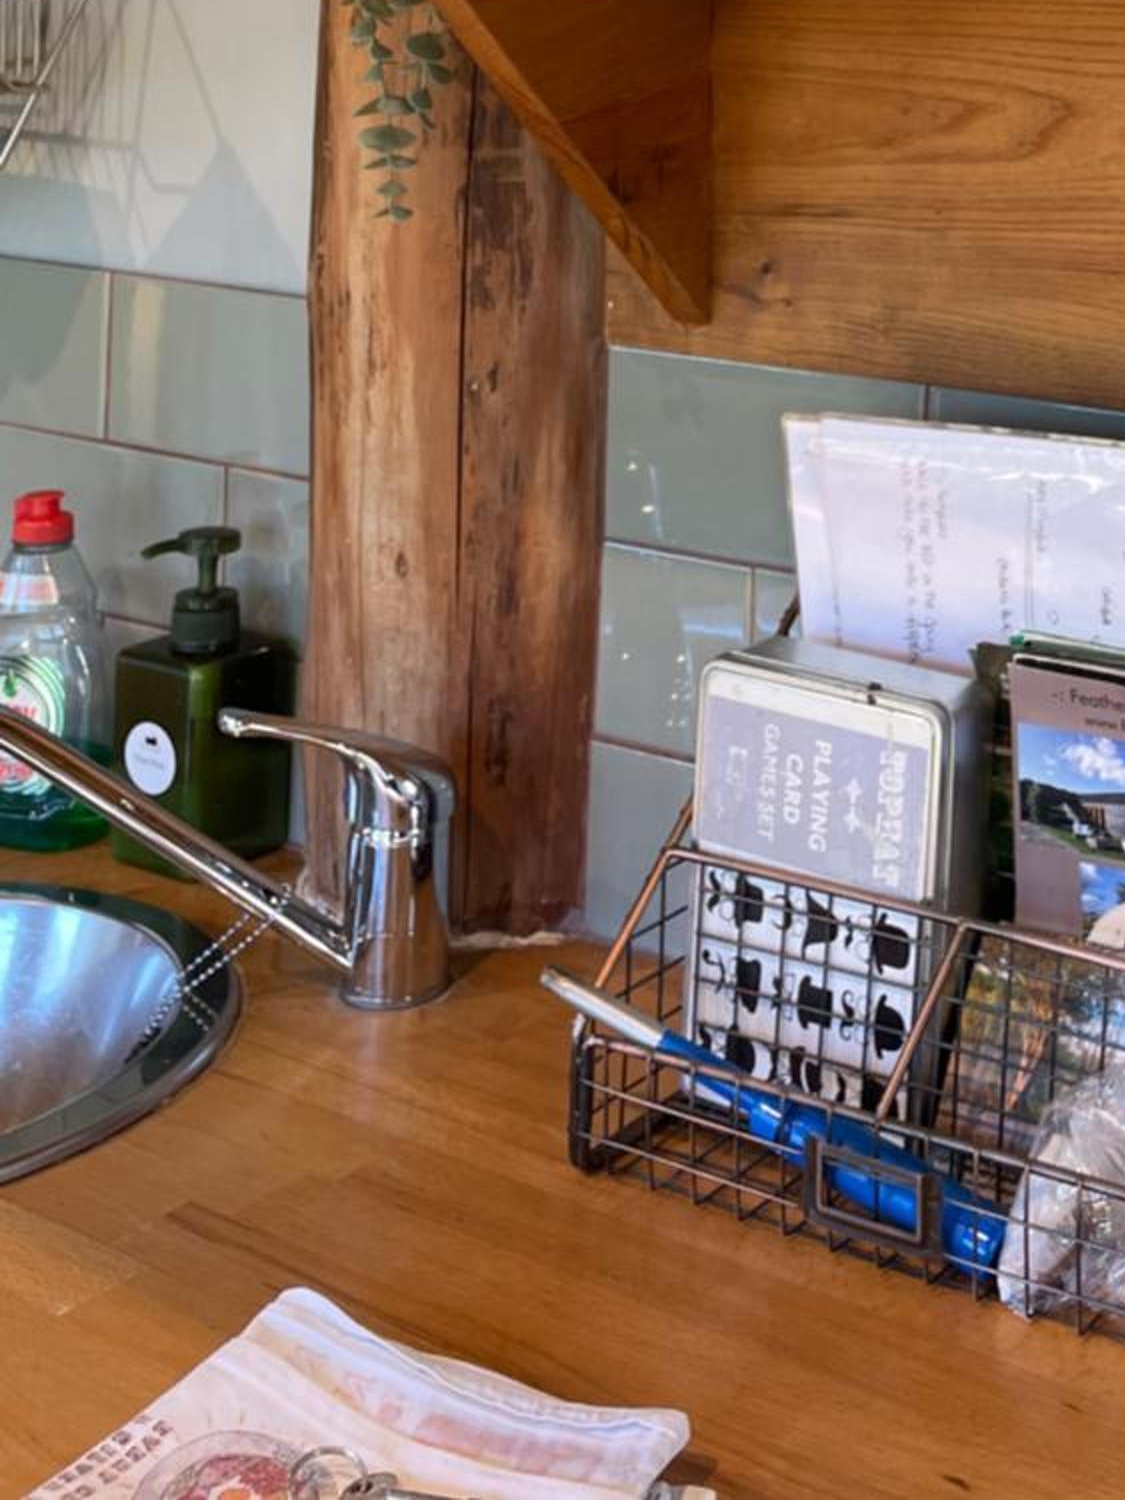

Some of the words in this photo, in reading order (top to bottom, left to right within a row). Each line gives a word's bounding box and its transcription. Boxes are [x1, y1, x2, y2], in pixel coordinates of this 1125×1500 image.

[757, 723, 782, 798] GAMES
[783, 754, 804, 825] CARD
[807, 739, 833, 854] PLAYING
[756, 801, 777, 842] SET
